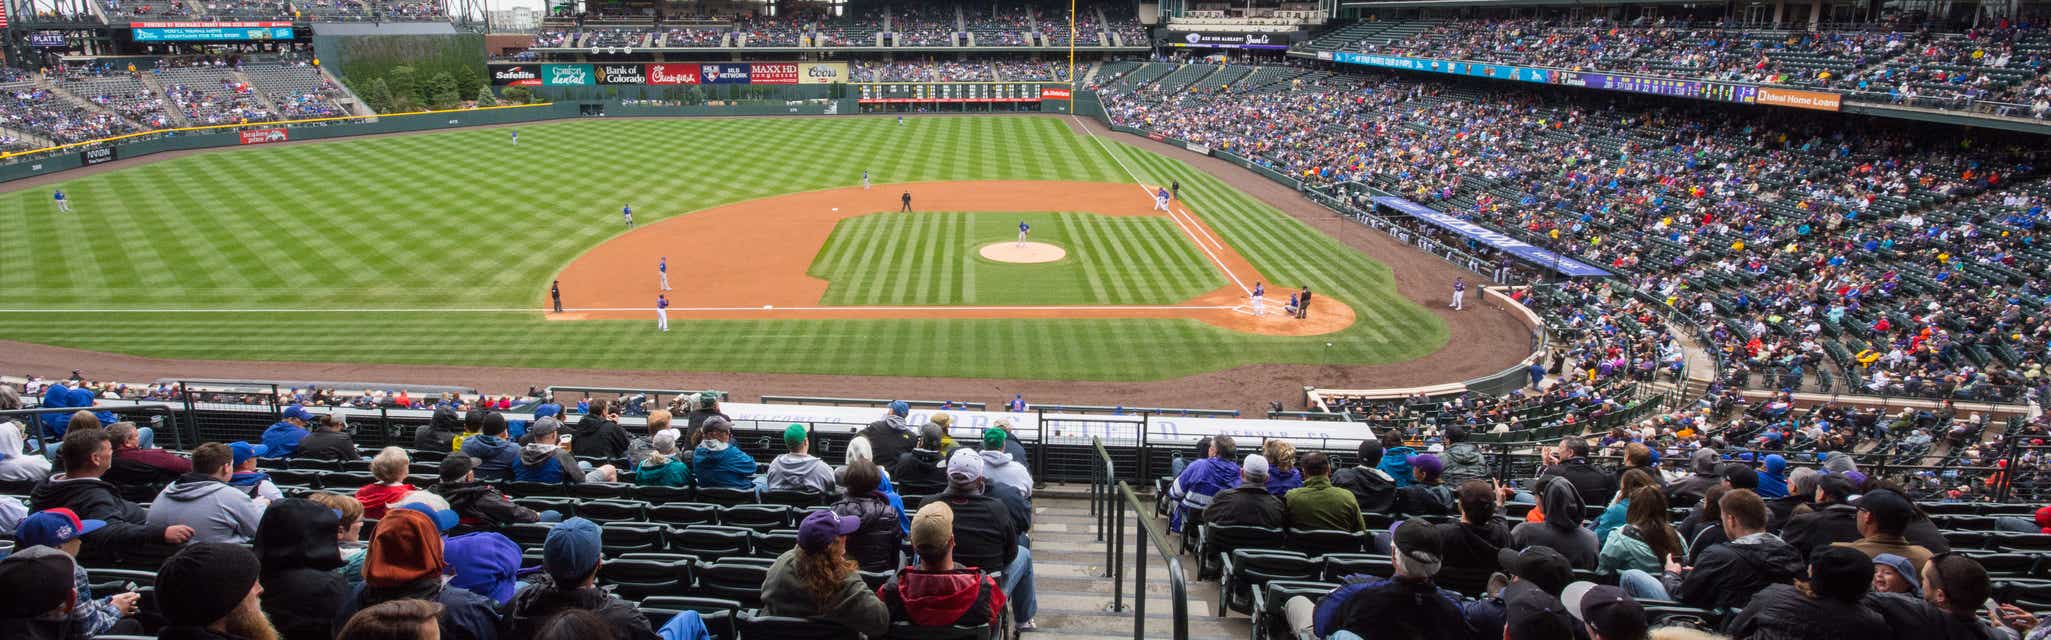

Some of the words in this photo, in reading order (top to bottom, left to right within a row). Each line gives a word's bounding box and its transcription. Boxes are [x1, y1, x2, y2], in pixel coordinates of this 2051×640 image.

[606, 66, 627, 75] Bank
[629, 66, 637, 75] of
[752, 65, 780, 73] MAXX
[782, 65, 797, 73] HD
[808, 66, 837, 78] Coors
[607, 75, 646, 84] Colorado
[1642, 84, 1649, 92] 22
[1767, 93, 1786, 102] Ideal
[1788, 95, 1811, 105] Home
[1813, 97, 1839, 107] Loans
[87, 147, 110, 159] ARROW
[740, 412, 816, 422] WELCOME
